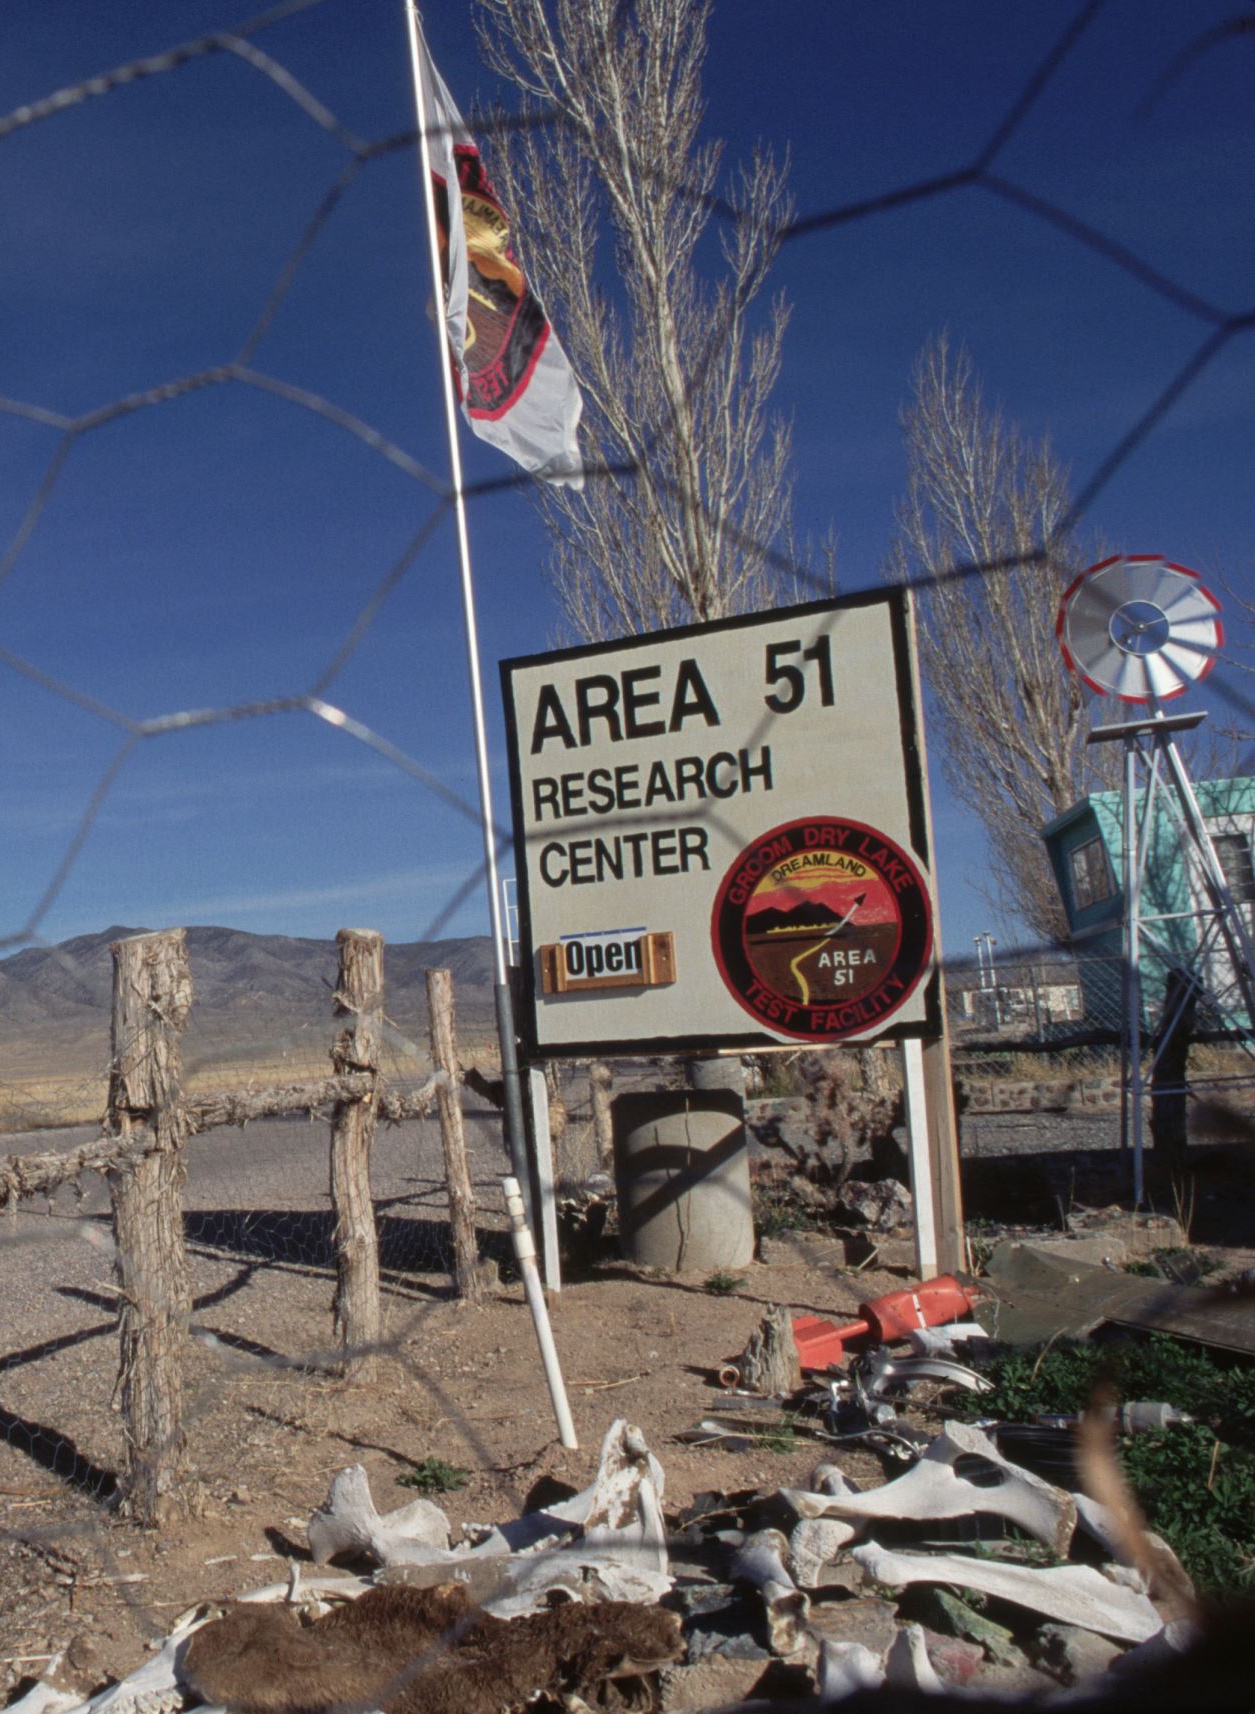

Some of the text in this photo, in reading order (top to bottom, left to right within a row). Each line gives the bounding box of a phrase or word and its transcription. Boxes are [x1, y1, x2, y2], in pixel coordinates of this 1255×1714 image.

[531, 635, 835, 755] AREA 51
[532, 746, 773, 822] RESEARCH
[539, 827, 711, 888] CENTER
[729, 827, 914, 905] GROOM DRY LAKE
[771, 854, 867, 882] DREAMLAND
[565, 940, 643, 977] Open
[819, 949, 877, 968] AREA
[834, 969, 854, 985] 51
[746, 974, 905, 1031] TEST FACILITY
